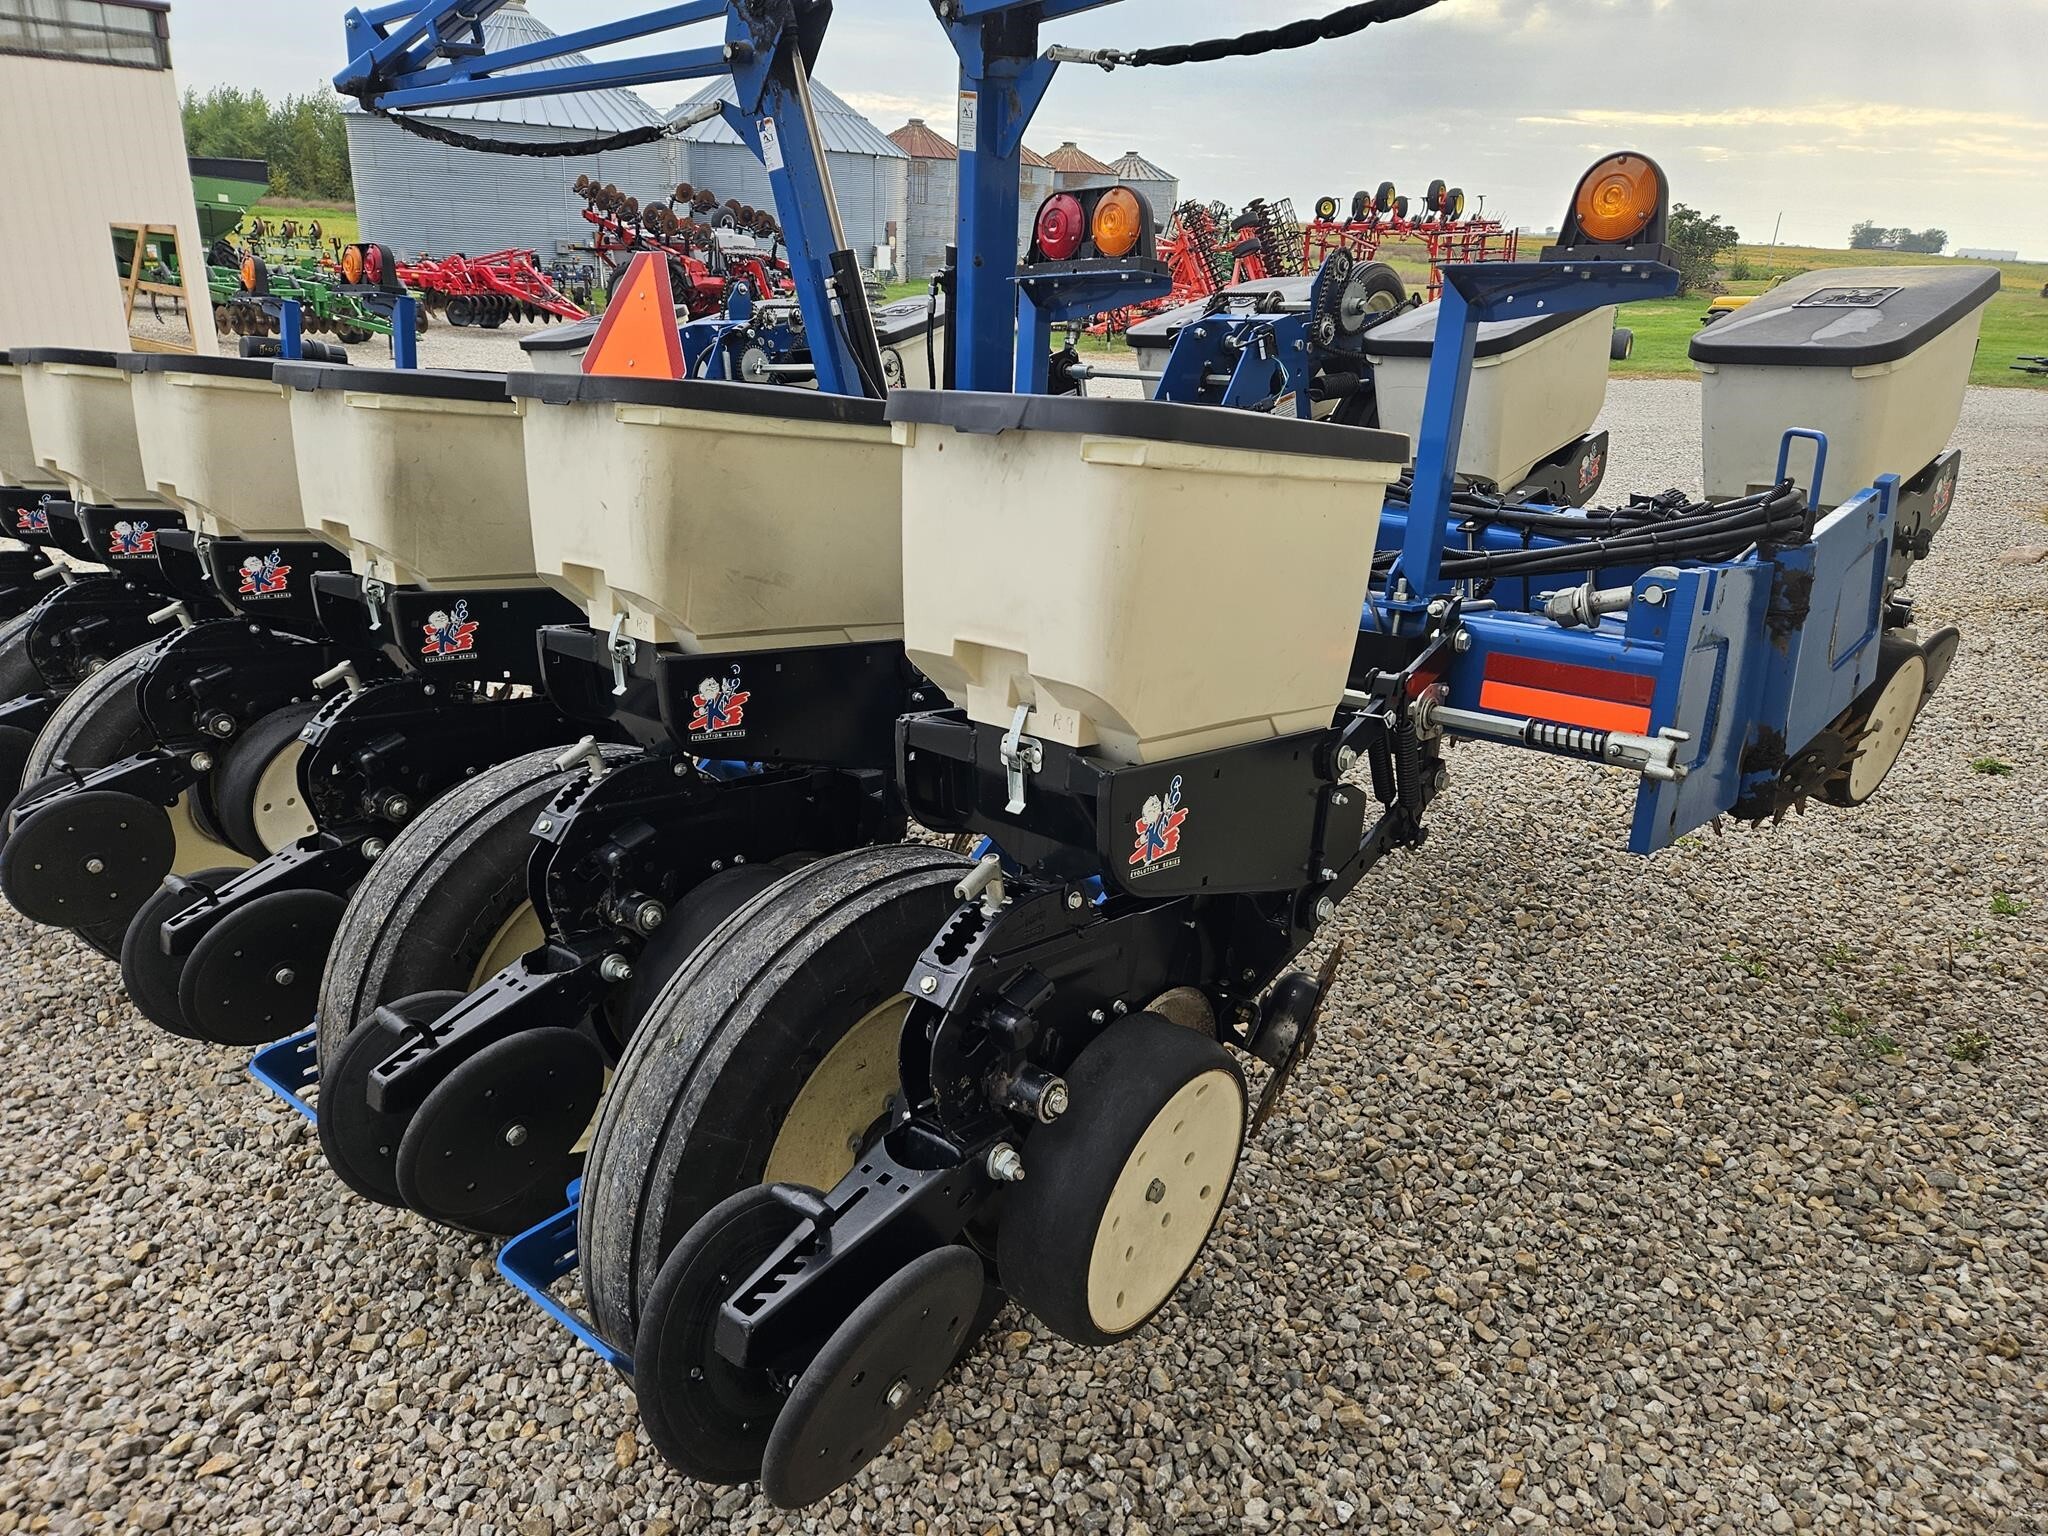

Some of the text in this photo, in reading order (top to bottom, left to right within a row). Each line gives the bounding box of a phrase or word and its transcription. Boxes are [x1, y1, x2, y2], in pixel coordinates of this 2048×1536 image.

[424, 652, 478, 663] EVOLUTION SERIES
[690, 730, 746, 741] EVOLUTION SERIES
[1130, 857, 1181, 878] EVOLUTION SERIES
